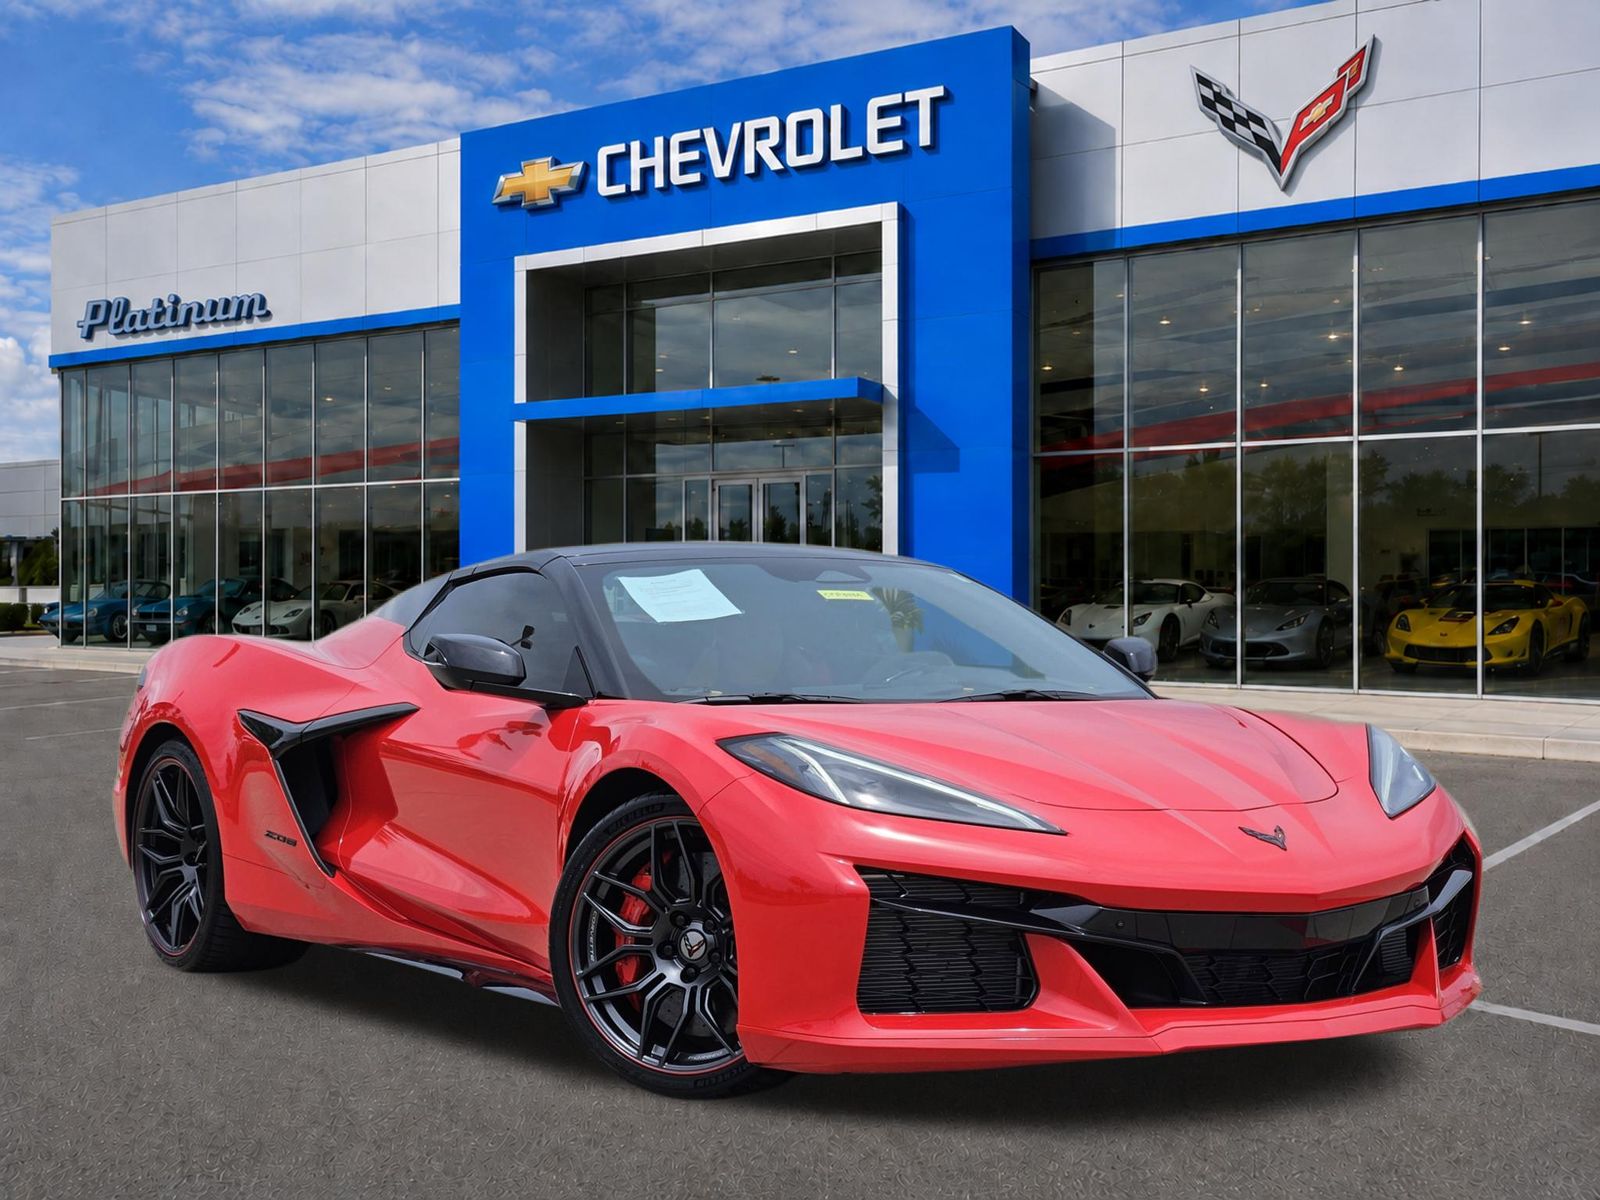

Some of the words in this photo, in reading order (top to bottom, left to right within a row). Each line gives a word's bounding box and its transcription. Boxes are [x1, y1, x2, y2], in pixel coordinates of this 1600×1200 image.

[597, 85, 947, 198] CHEVROLET
[77, 293, 271, 340] Platinum
[264, 830, 297, 847] Z06
